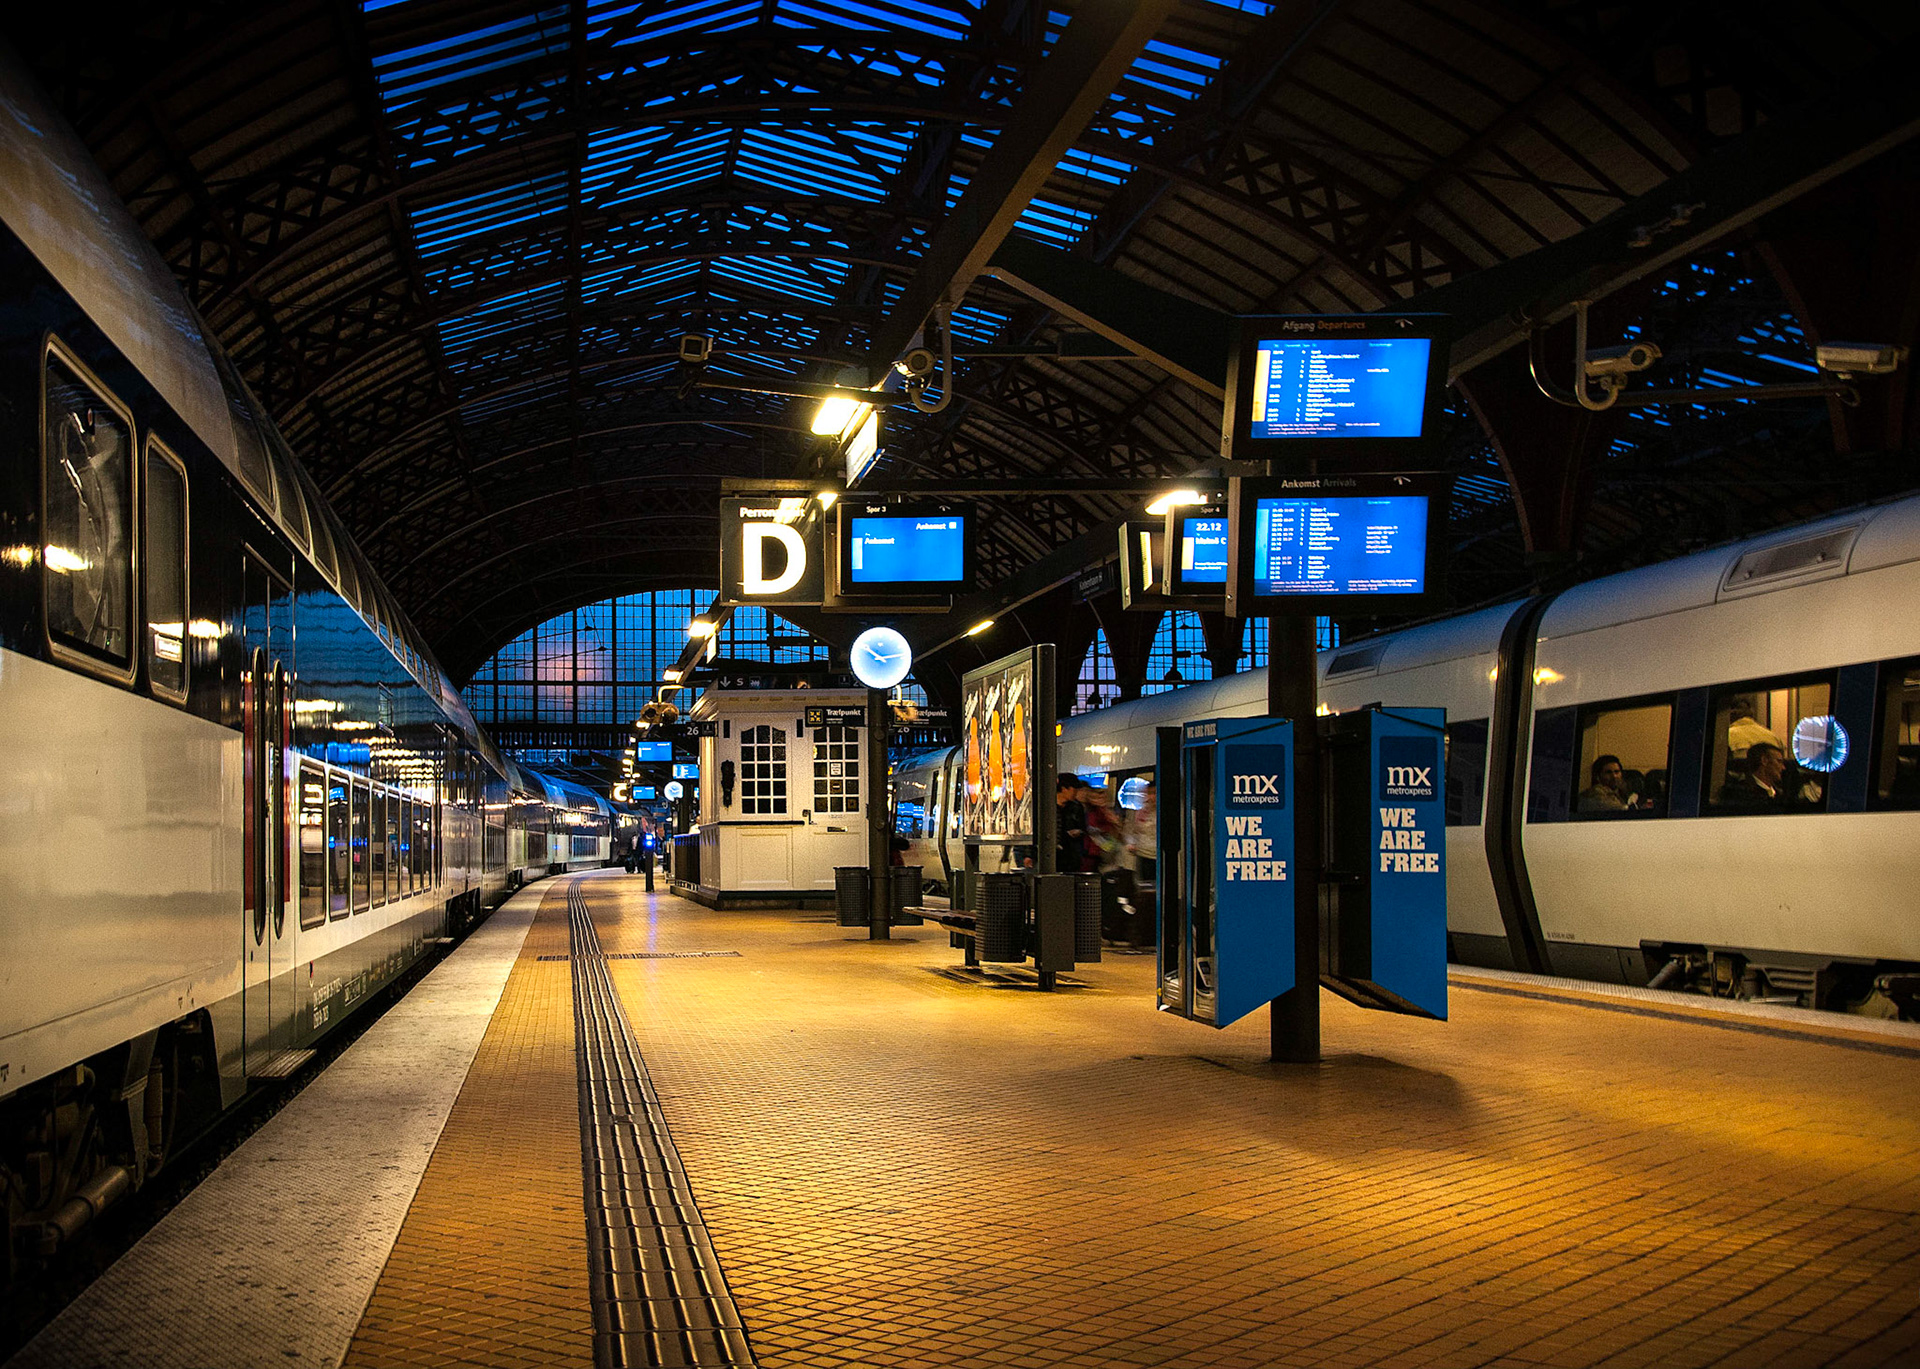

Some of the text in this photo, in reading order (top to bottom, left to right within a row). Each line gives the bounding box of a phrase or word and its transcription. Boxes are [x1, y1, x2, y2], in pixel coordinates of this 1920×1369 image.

[1282, 320, 1366, 332] Afgang Departures
[1281, 478, 1357, 489] Ankomst Arrivals
[866, 505, 887, 514] Spor 3
[1195, 522, 1222, 532] 22.12
[742, 522, 807, 595] D
[826, 708, 862, 717] Træfpunkt
[686, 726, 699, 736] 26
[1232, 774, 1279, 795] mx
[1387, 766, 1432, 787] mx
[1232, 795, 1279, 805] metroxpress
[1386, 787, 1432, 796] metroxpress
[1225, 816, 1263, 836] WE
[1379, 807, 1416, 828] WE
[1225, 838, 1273, 859] ARE
[1379, 830, 1426, 850] ARE
[1225, 861, 1287, 881] FREE
[1380, 852, 1440, 873] FREE
